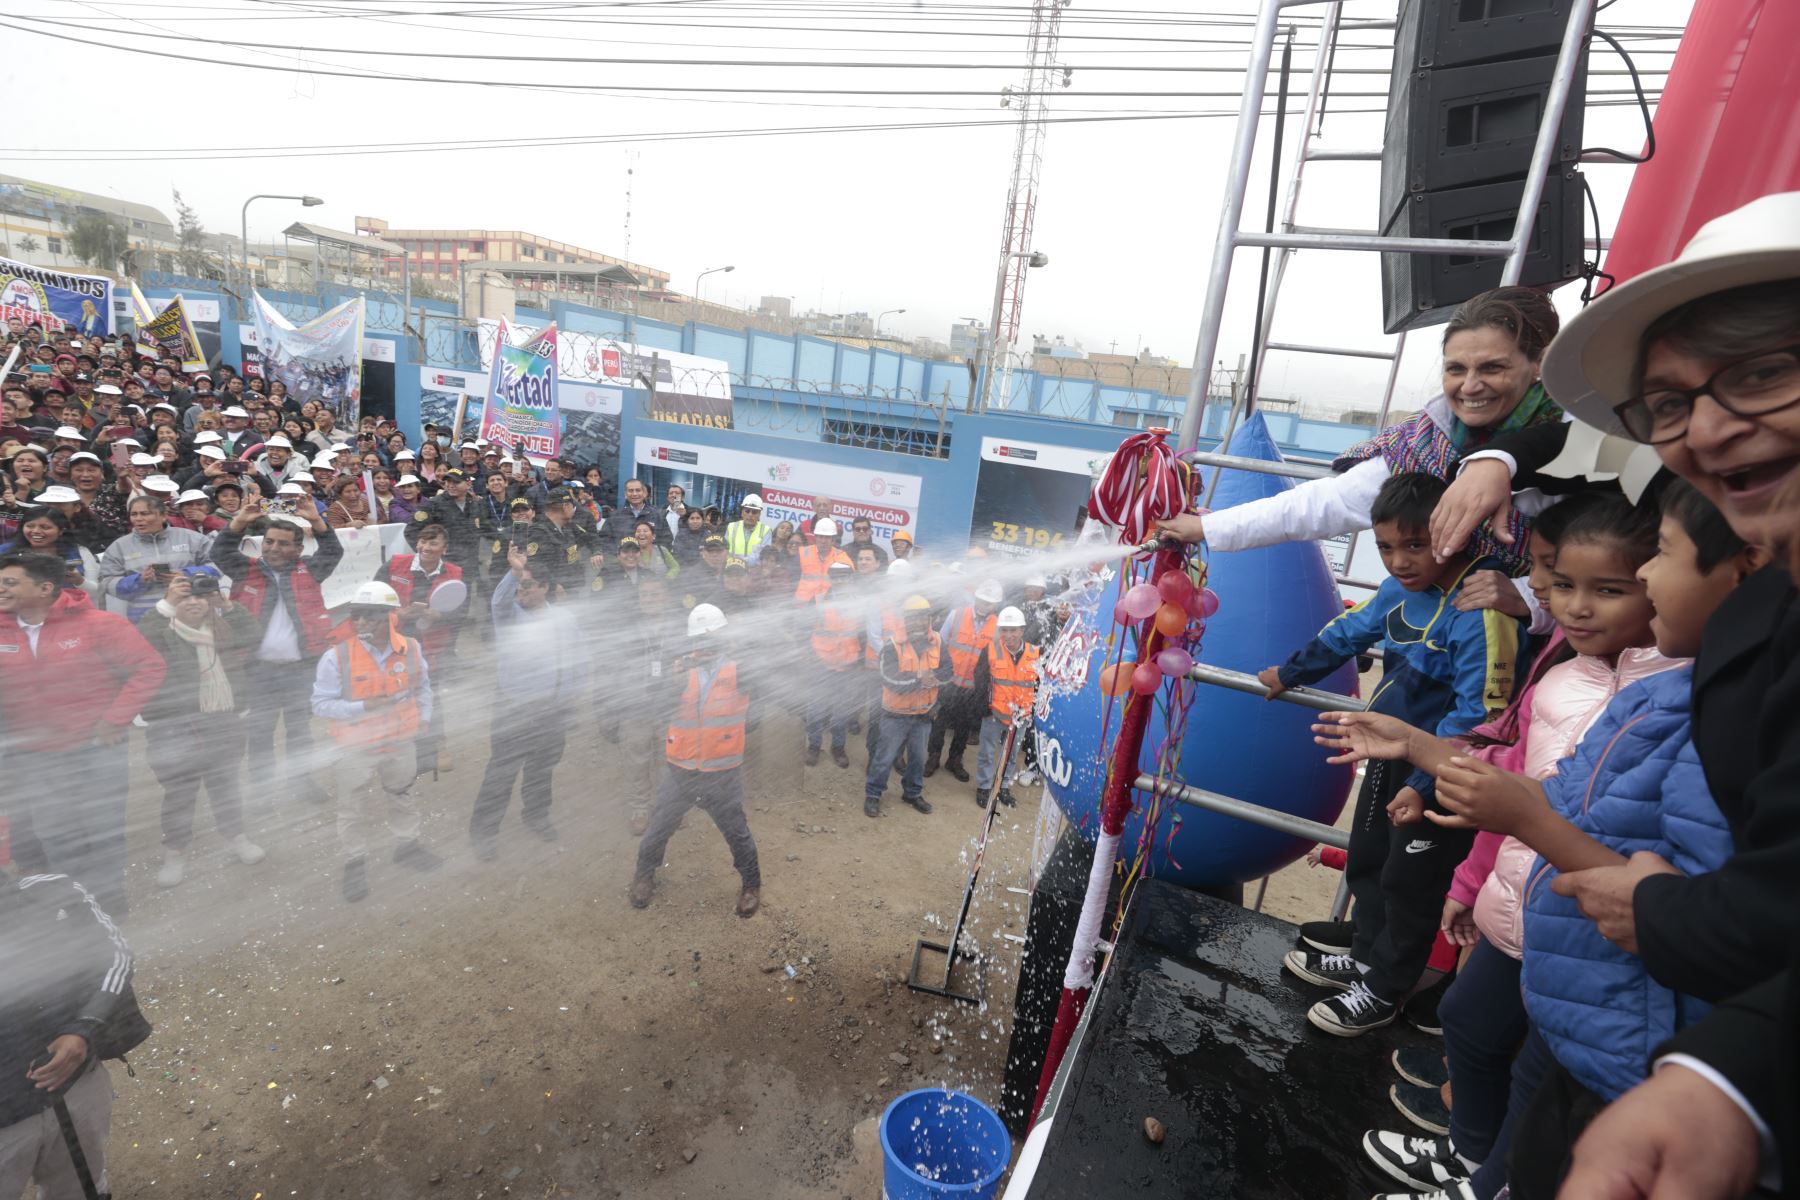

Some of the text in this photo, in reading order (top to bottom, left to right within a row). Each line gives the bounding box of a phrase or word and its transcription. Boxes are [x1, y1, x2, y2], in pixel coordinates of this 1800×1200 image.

[766, 491, 905, 526] CÁMARA DERIVACIÓN
[991, 521, 1020, 543] 33
[1410, 839, 1433, 848] NIKE
